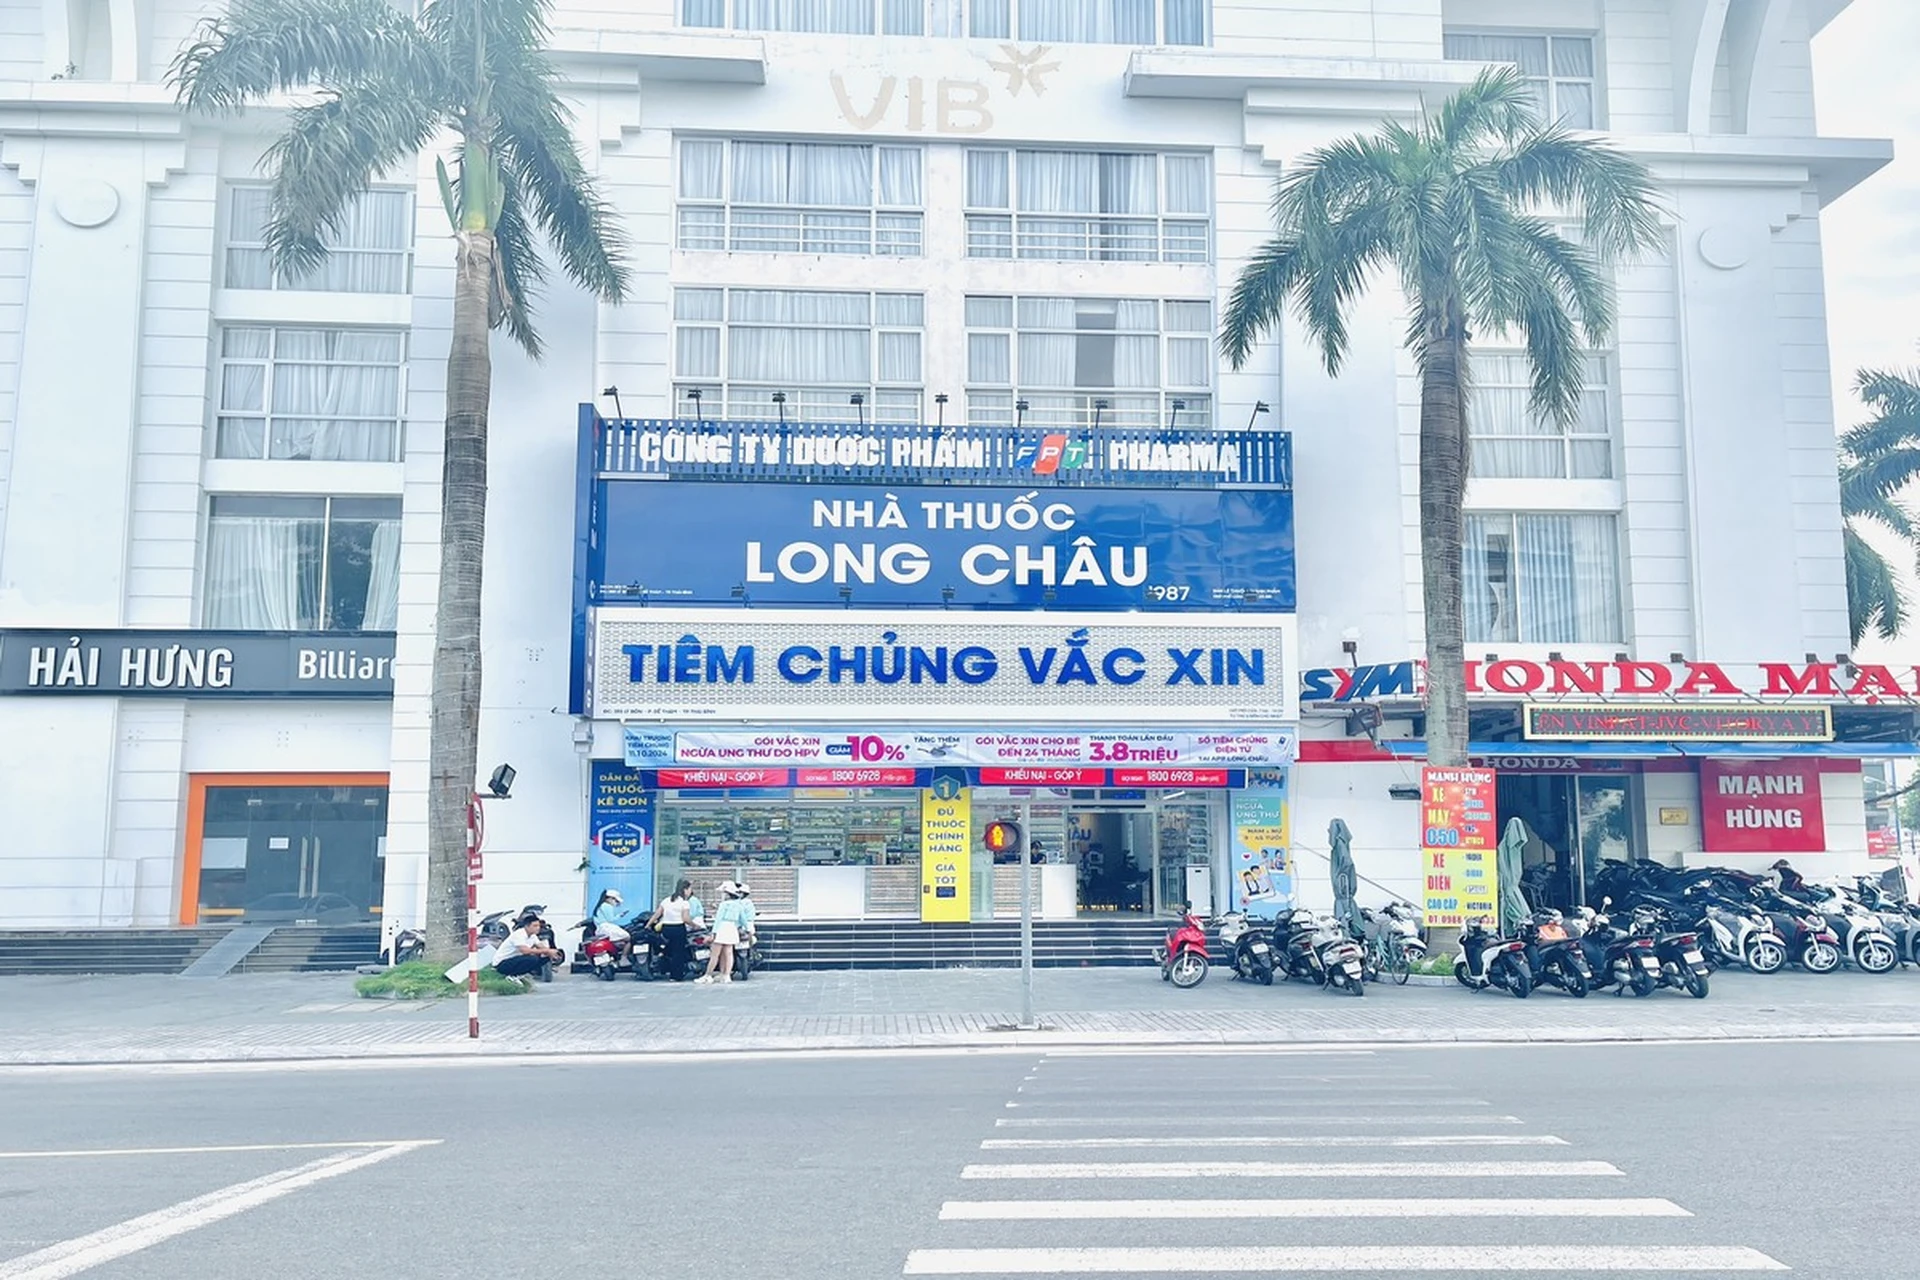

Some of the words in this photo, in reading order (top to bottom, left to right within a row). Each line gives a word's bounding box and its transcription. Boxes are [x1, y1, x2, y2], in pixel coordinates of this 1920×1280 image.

[829, 72, 994, 134] VIB
[639, 429, 732, 463] CÔNG
[742, 434, 780, 465] TY
[1016, 441, 1087, 468] FPT
[1109, 440, 1240, 473] PHARMA
[813, 493, 905, 529] NHÀ
[921, 490, 1076, 531] THUỐC
[745, 542, 931, 586] LONG
[961, 536, 1149, 587] CHÂU
[29, 636, 100, 687] HẢI
[120, 643, 234, 688] HƯNG
[623, 635, 755, 683] TIÊM
[778, 629, 999, 685] CHỦNG
[1019, 627, 1147, 685] VẮC
[1166, 647, 1265, 685] XIN
[1299, 661, 1413, 702] SYM
[755, 736, 774, 746] GÓI
[802, 737, 820, 746] XIN
[976, 736, 995, 745] GÓI
[1021, 737, 1039, 745] XIN
[1041, 737, 1064, 746] CHO
[681, 746, 716, 758] NGỪA
[718, 748, 744, 758] UNG
[747, 748, 772, 758] THƯ
[774, 748, 792, 758] DO
[795, 748, 820, 758] HPV
[1024, 748, 1038, 757] 24
[1040, 746, 1081, 757] THÁNG
[1089, 742, 1129, 762] 3.8
[1129, 747, 1179, 764] TRIỆU
[1483, 757, 1582, 769] HONDA
[832, 771, 854, 781] 1800
[856, 771, 881, 781] 6928
[1147, 771, 1168, 781] 1800
[1170, 771, 1194, 781] 6928
[1432, 787, 1445, 802] XE
[1719, 775, 1804, 798] MẠNH
[1726, 804, 1803, 829] HÙNG
[1426, 827, 1459, 847] C50
[1432, 853, 1445, 868] XE
[1427, 898, 1442, 909] CAO
